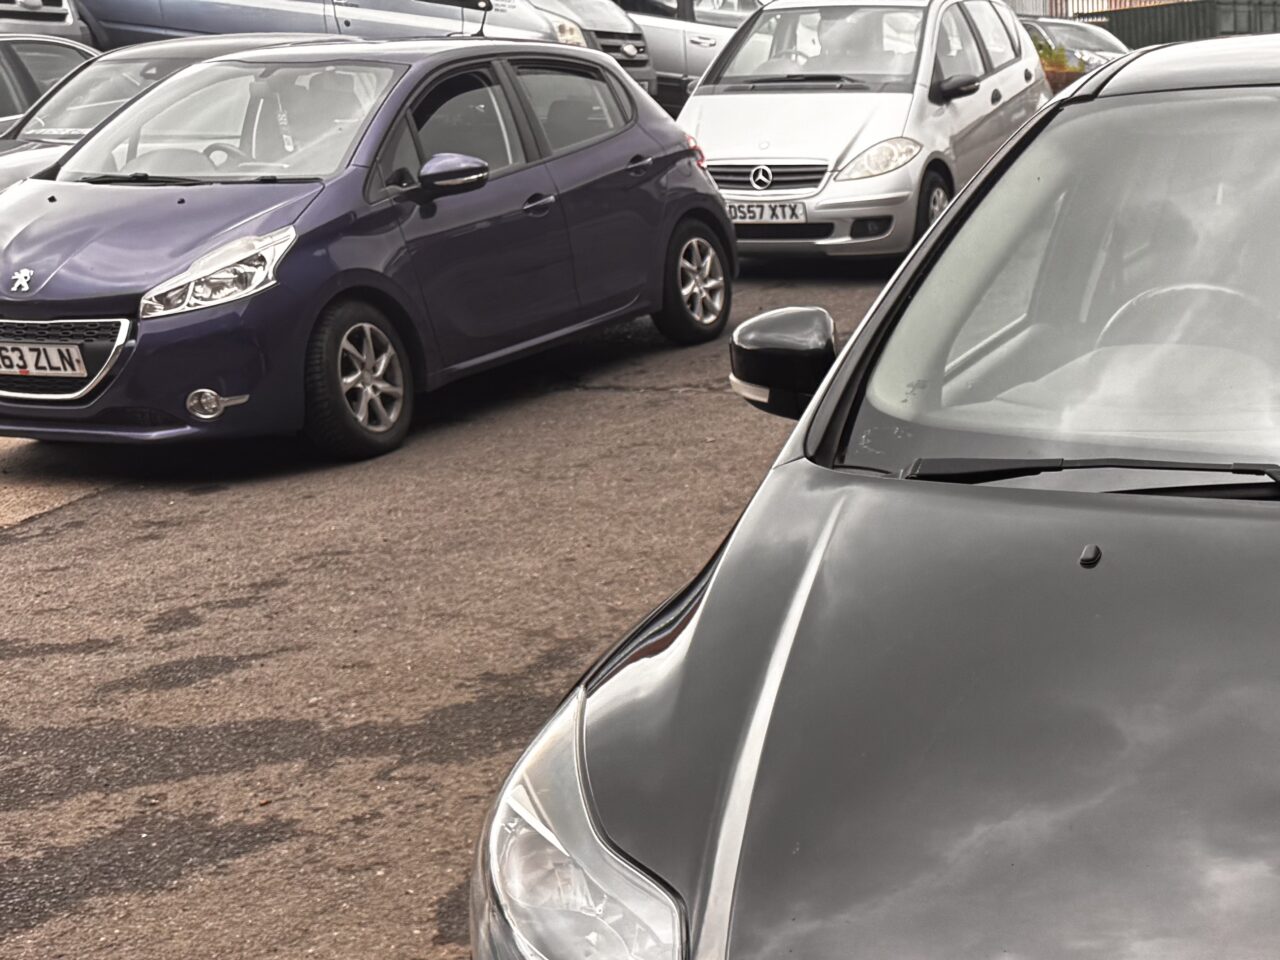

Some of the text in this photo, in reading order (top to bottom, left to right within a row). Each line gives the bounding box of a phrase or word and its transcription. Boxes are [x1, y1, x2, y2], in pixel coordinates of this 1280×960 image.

[728, 204, 800, 220] DS57 XTX
[0, 346, 76, 372] 63 ZLN
